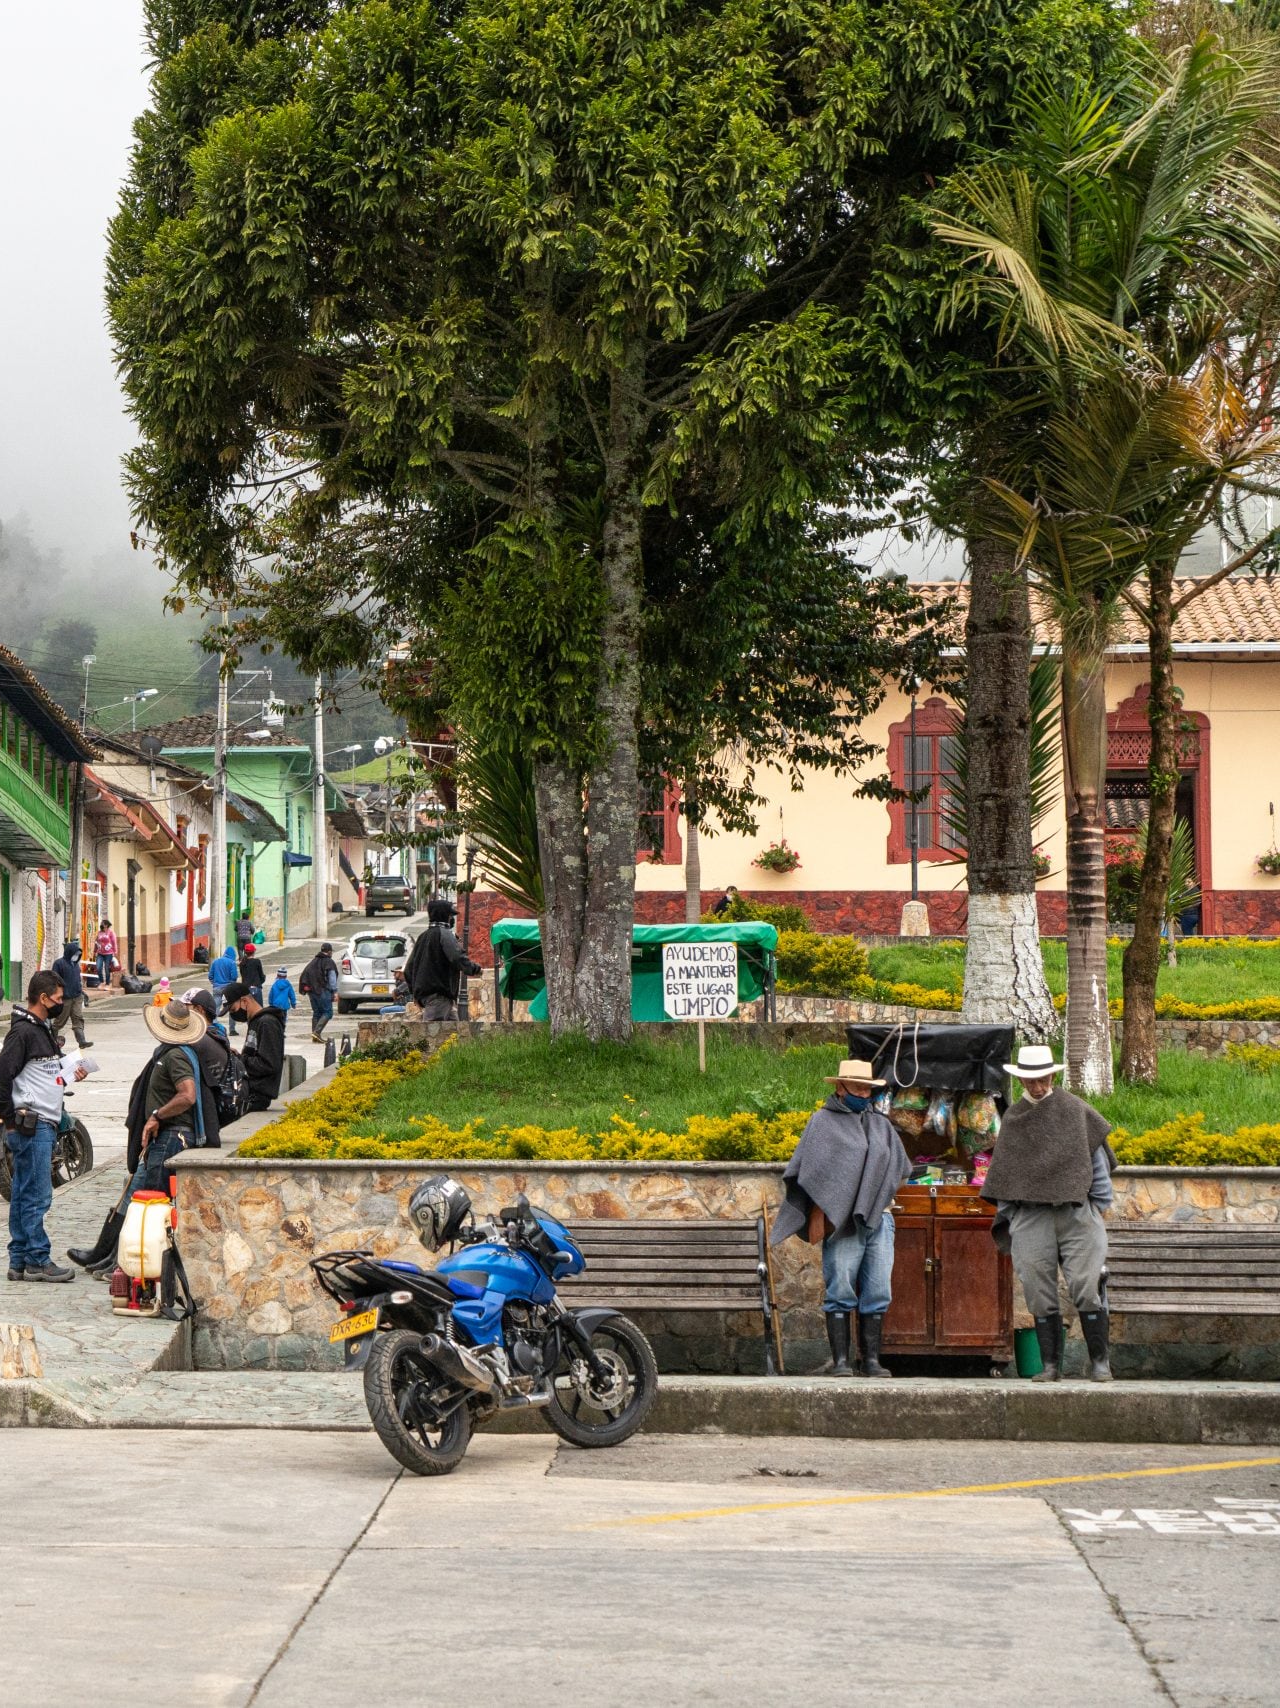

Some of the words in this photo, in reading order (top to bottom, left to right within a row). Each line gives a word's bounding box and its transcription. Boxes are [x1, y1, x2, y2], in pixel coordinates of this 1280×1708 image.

[666, 946, 736, 962] AYUDEMOS
[666, 966, 676, 980] A
[678, 964, 737, 979] MANTENER
[666, 983, 693, 996] ESTE
[696, 983, 736, 996] LUGAR
[674, 996, 729, 1016] LIMPIO
